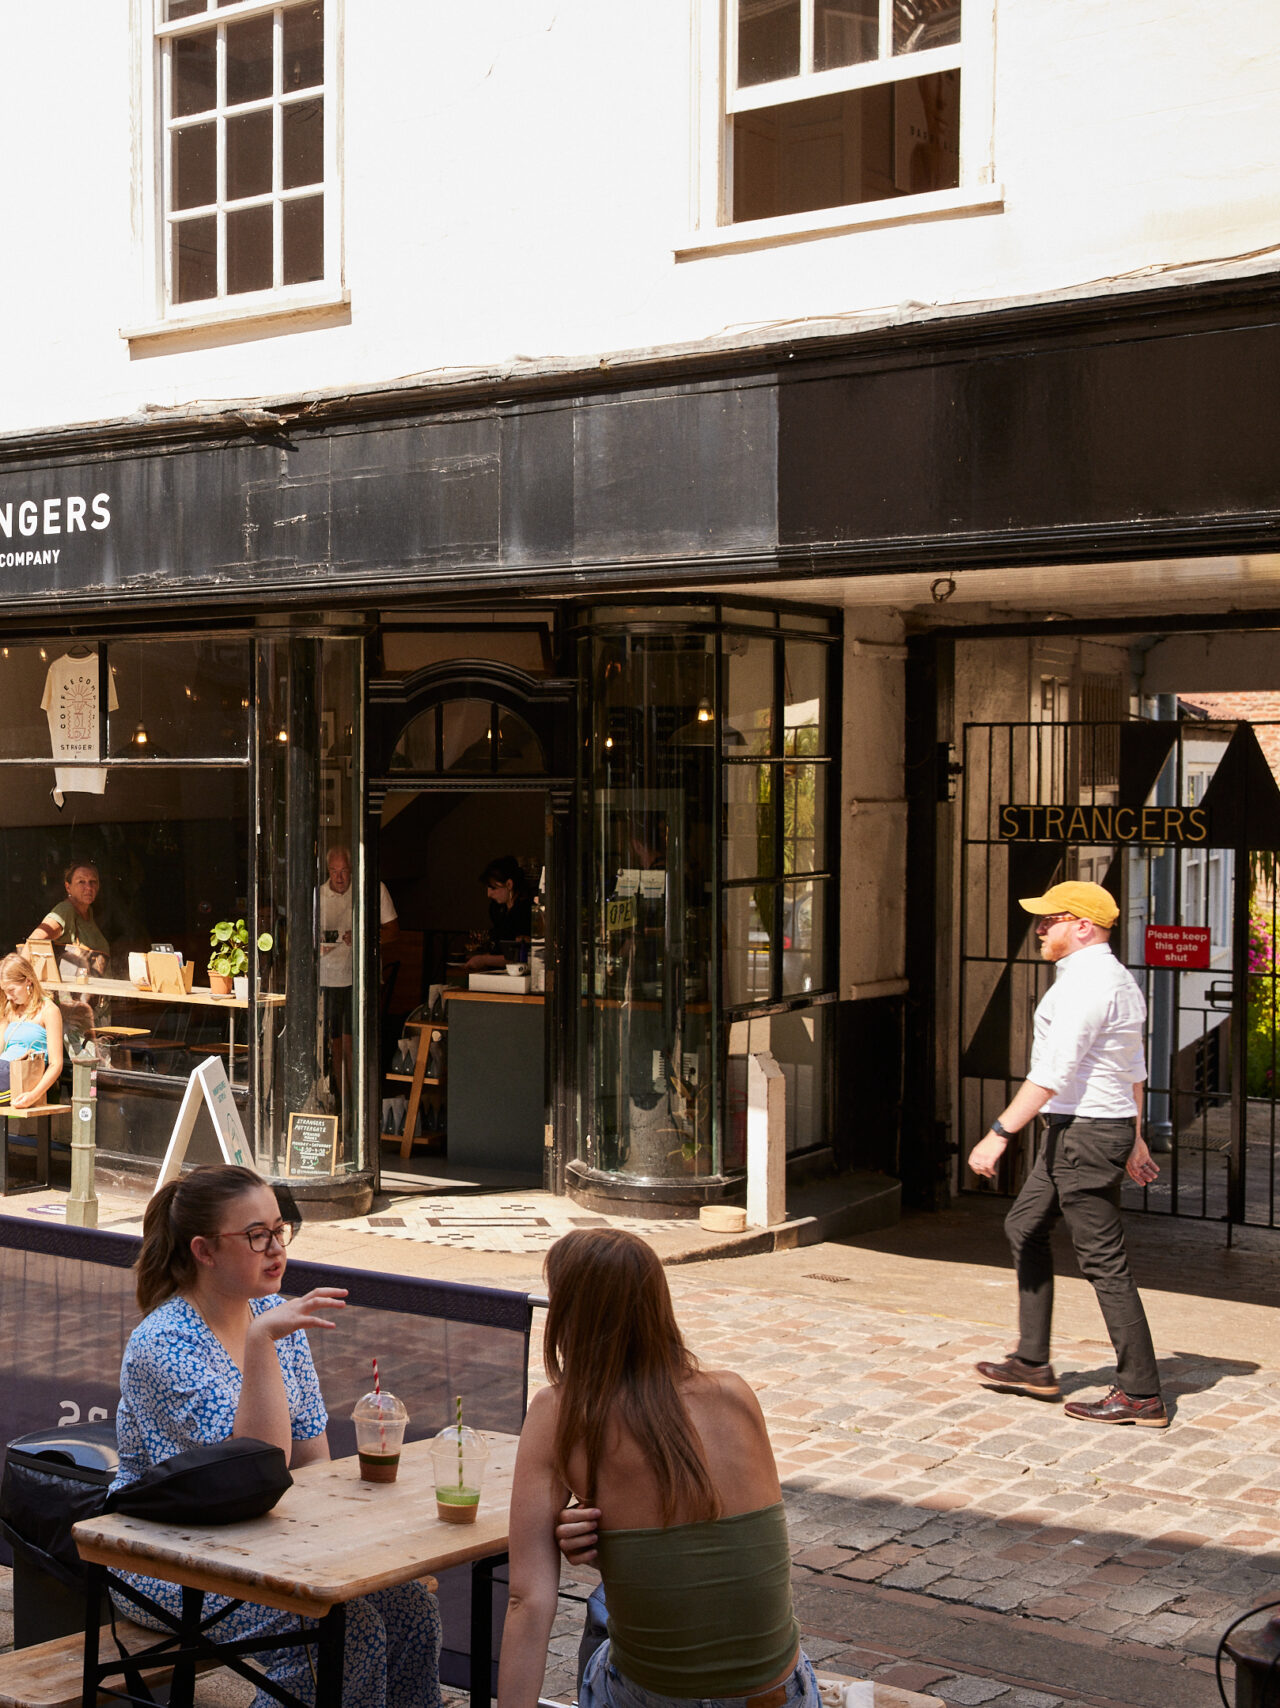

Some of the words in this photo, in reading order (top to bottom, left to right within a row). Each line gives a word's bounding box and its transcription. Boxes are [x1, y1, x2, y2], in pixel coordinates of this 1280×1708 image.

[1001, 806, 1207, 842] STRANGERS
[1147, 930, 1180, 940] Please
[1182, 931, 1208, 944] keep
[1155, 941, 1174, 951] this
[1176, 943, 1198, 953] gate
[1164, 952, 1188, 962] shut
